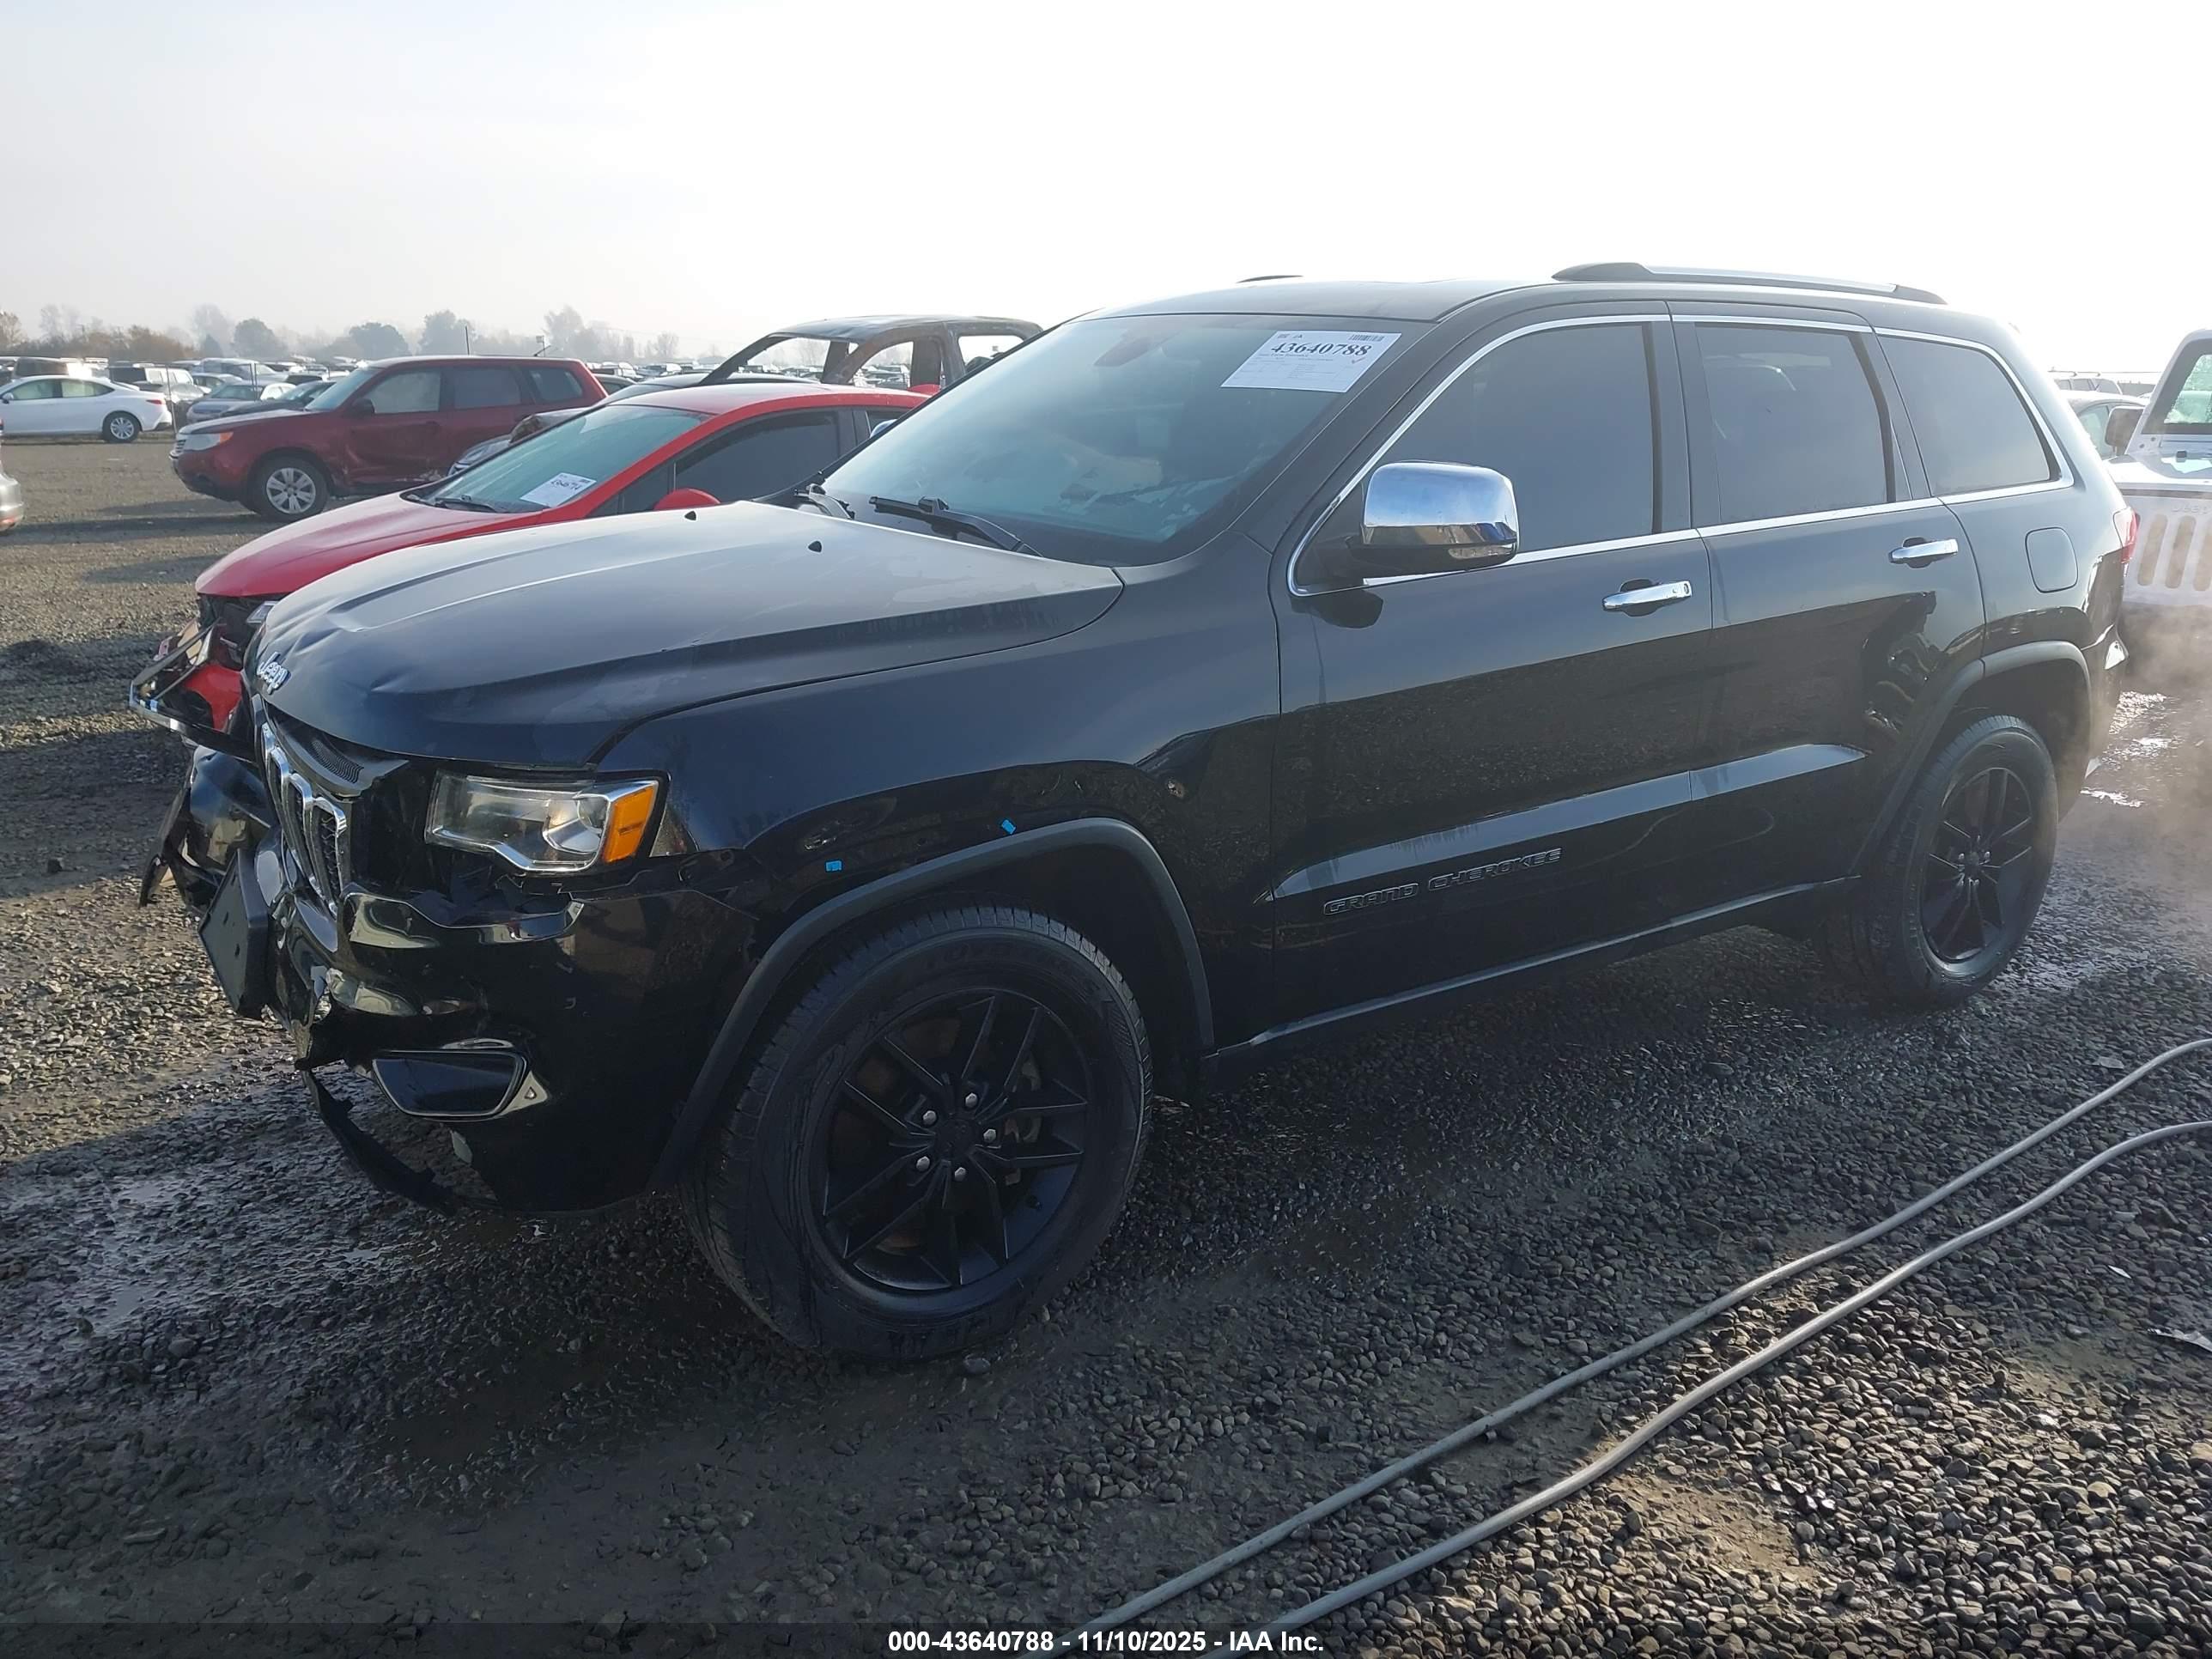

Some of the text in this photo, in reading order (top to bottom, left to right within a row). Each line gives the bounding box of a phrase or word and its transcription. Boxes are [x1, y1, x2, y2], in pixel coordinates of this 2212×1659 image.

[1271, 342, 1373, 356] 43640788
[1322, 848, 1563, 915] GRAND CHEROKEE
